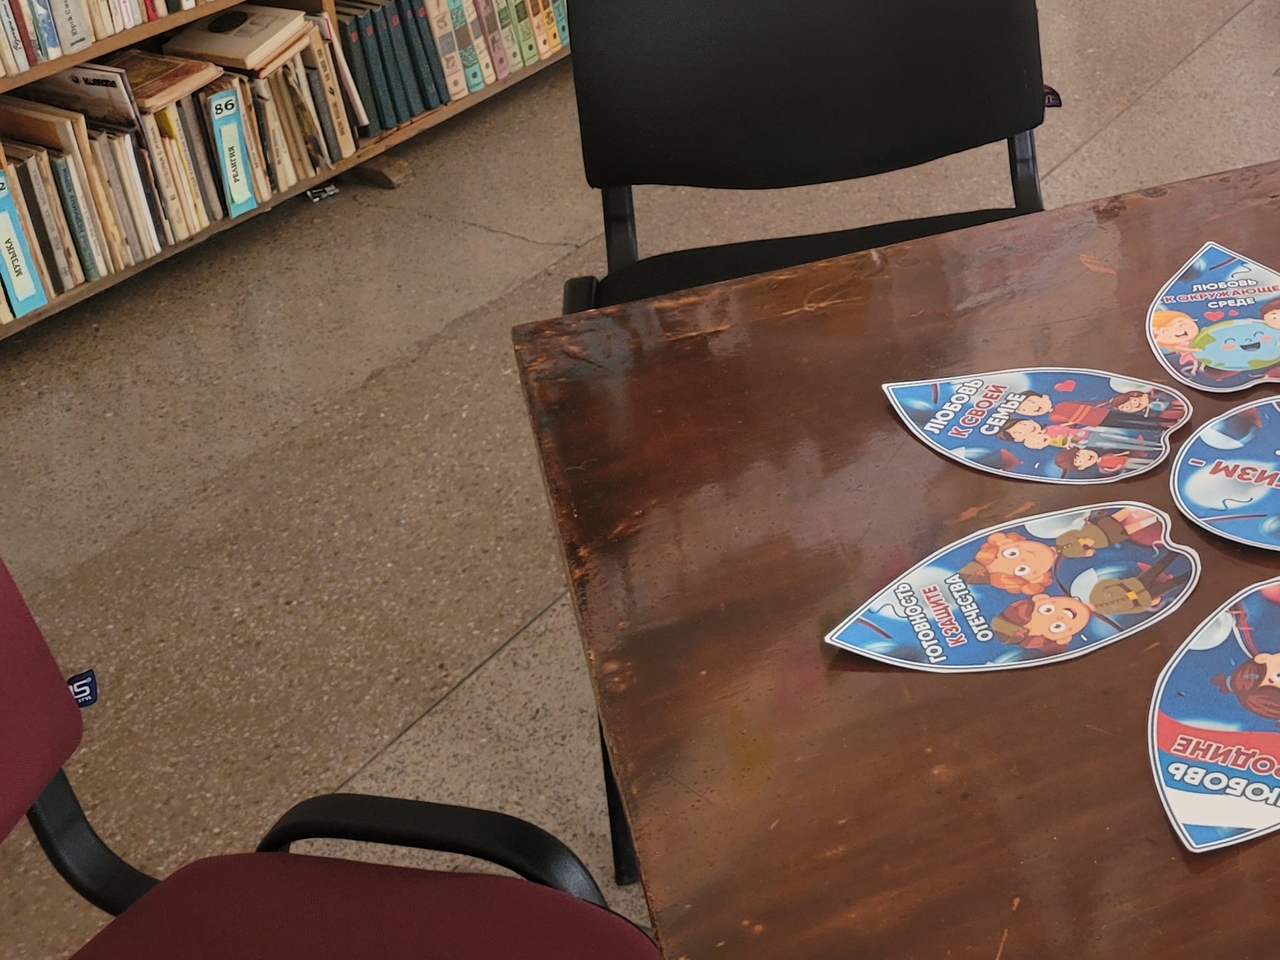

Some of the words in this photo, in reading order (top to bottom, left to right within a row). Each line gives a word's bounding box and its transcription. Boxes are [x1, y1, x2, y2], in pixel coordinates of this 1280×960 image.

[214, 99, 235, 115] 86
[227, 146, 240, 182] РЕЛИГИЯ
[6, 238, 23, 277] МУЗЫКА
[1163, 295, 1175, 304] К
[1192, 278, 1258, 292] ЛЮБОВЬ
[1207, 297, 1257, 309] СРЕДЕ
[923, 378, 985, 435] ЛЮБОВЬ
[948, 421, 970, 439] К
[960, 383, 1009, 428] СВОЕЙ
[979, 392, 1027, 435] СЕМЬЕ
[893, 581, 948, 664] ГОТОВНОСТЬ
[921, 584, 960, 638] ЗАЩИТЕ
[944, 573, 994, 643] ОТЕЧЕСТВА
[948, 633, 968, 648] К
